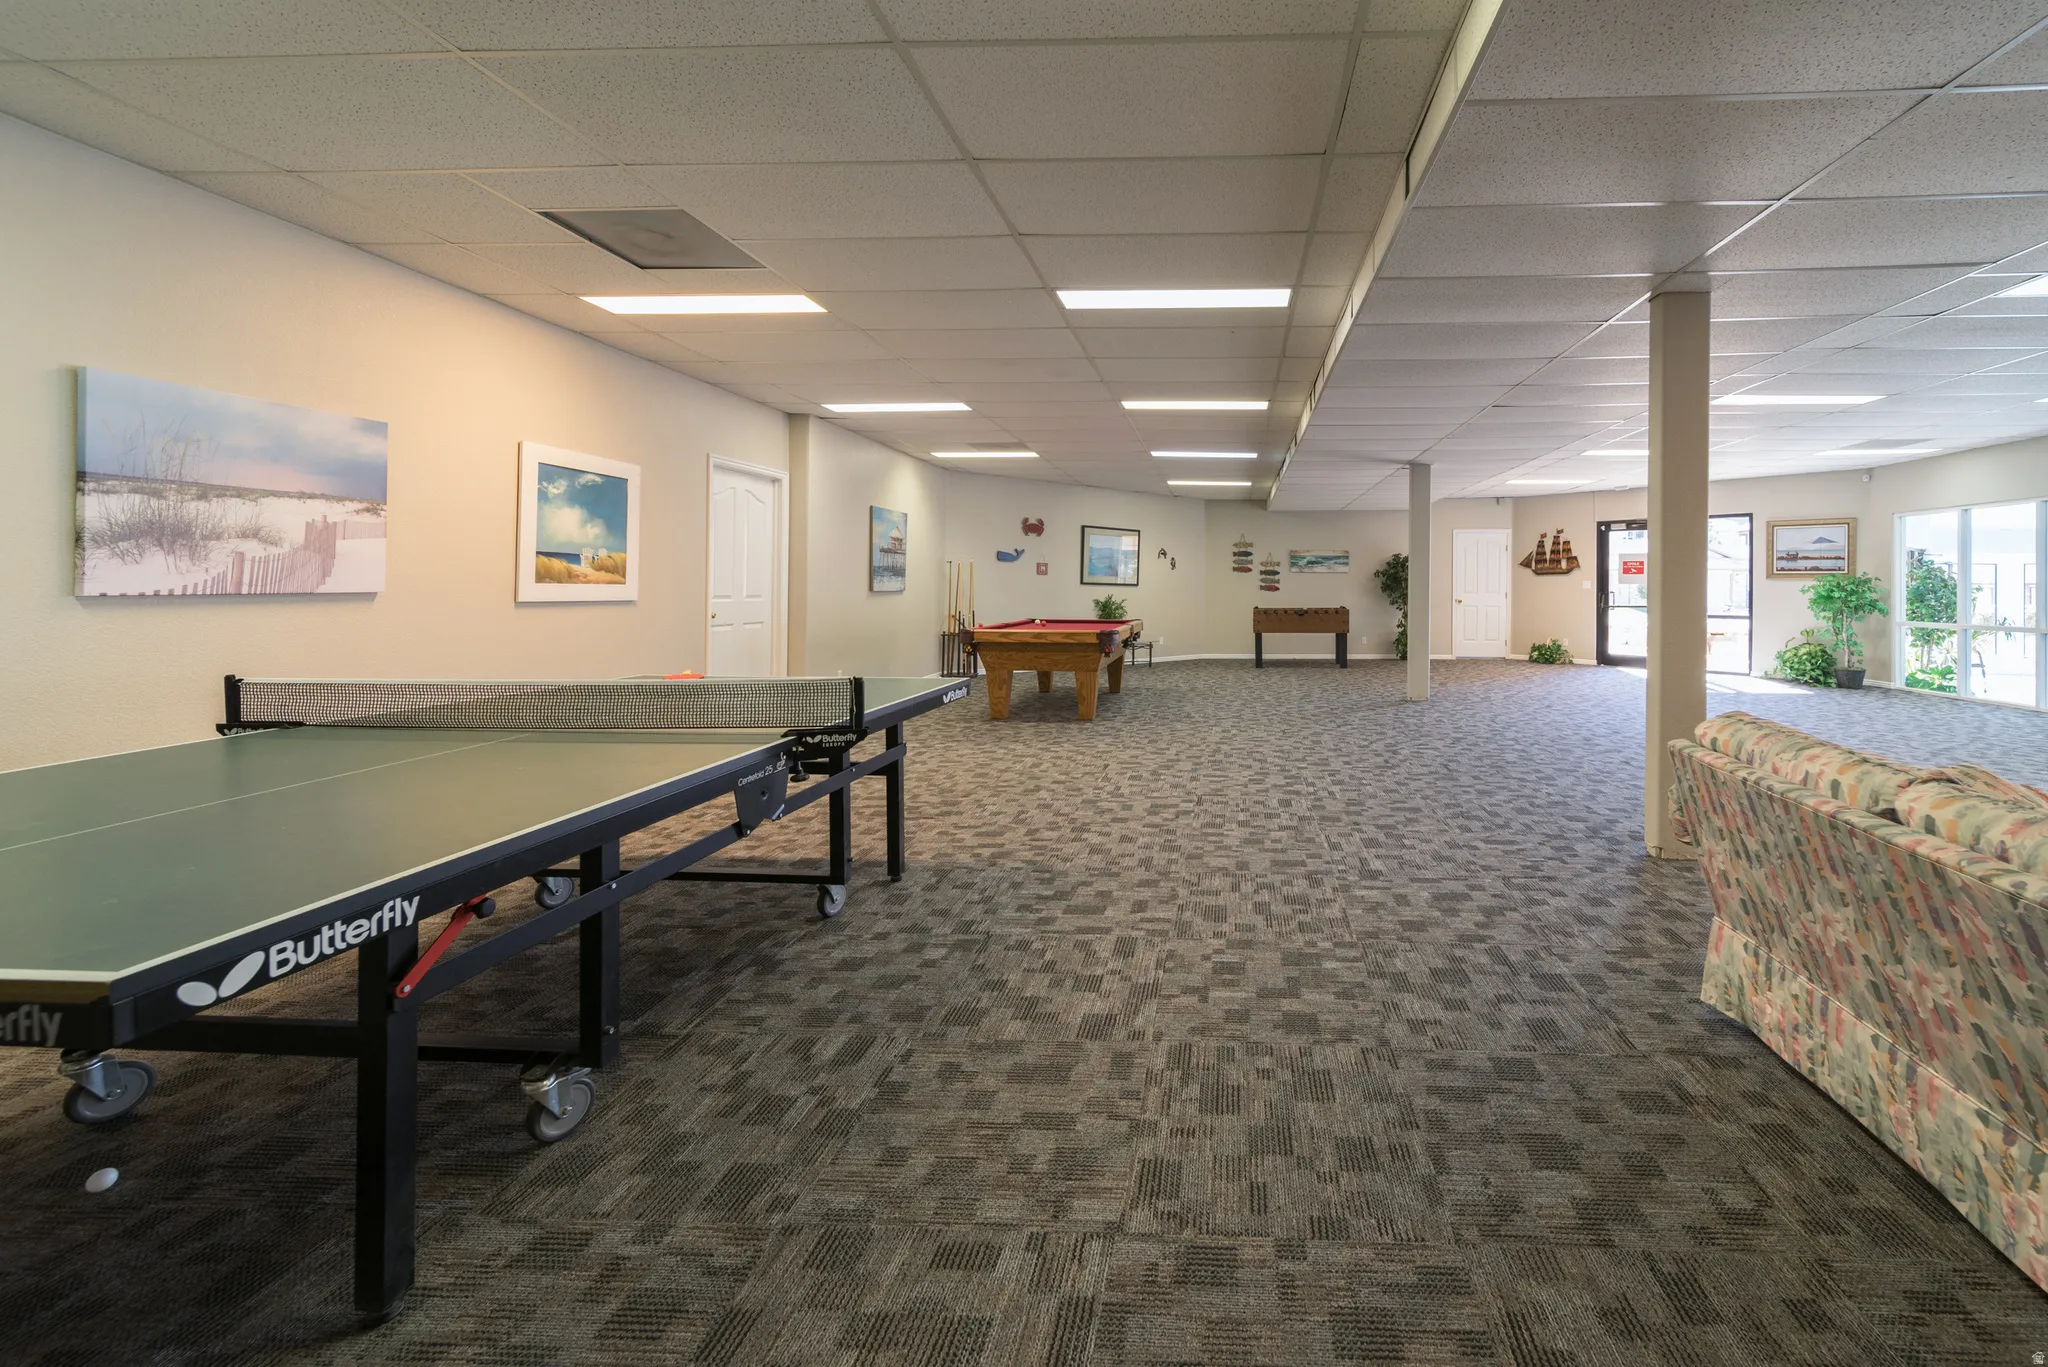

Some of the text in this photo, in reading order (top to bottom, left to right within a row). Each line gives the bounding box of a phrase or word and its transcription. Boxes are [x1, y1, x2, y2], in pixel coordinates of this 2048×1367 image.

[950, 686, 968, 702] Butterfly
[822, 733, 857, 742] Butterfly
[738, 764, 774, 787] Centrefold 25
[268, 895, 421, 979] Butterfly
[0, 1003, 64, 1047] rfly
